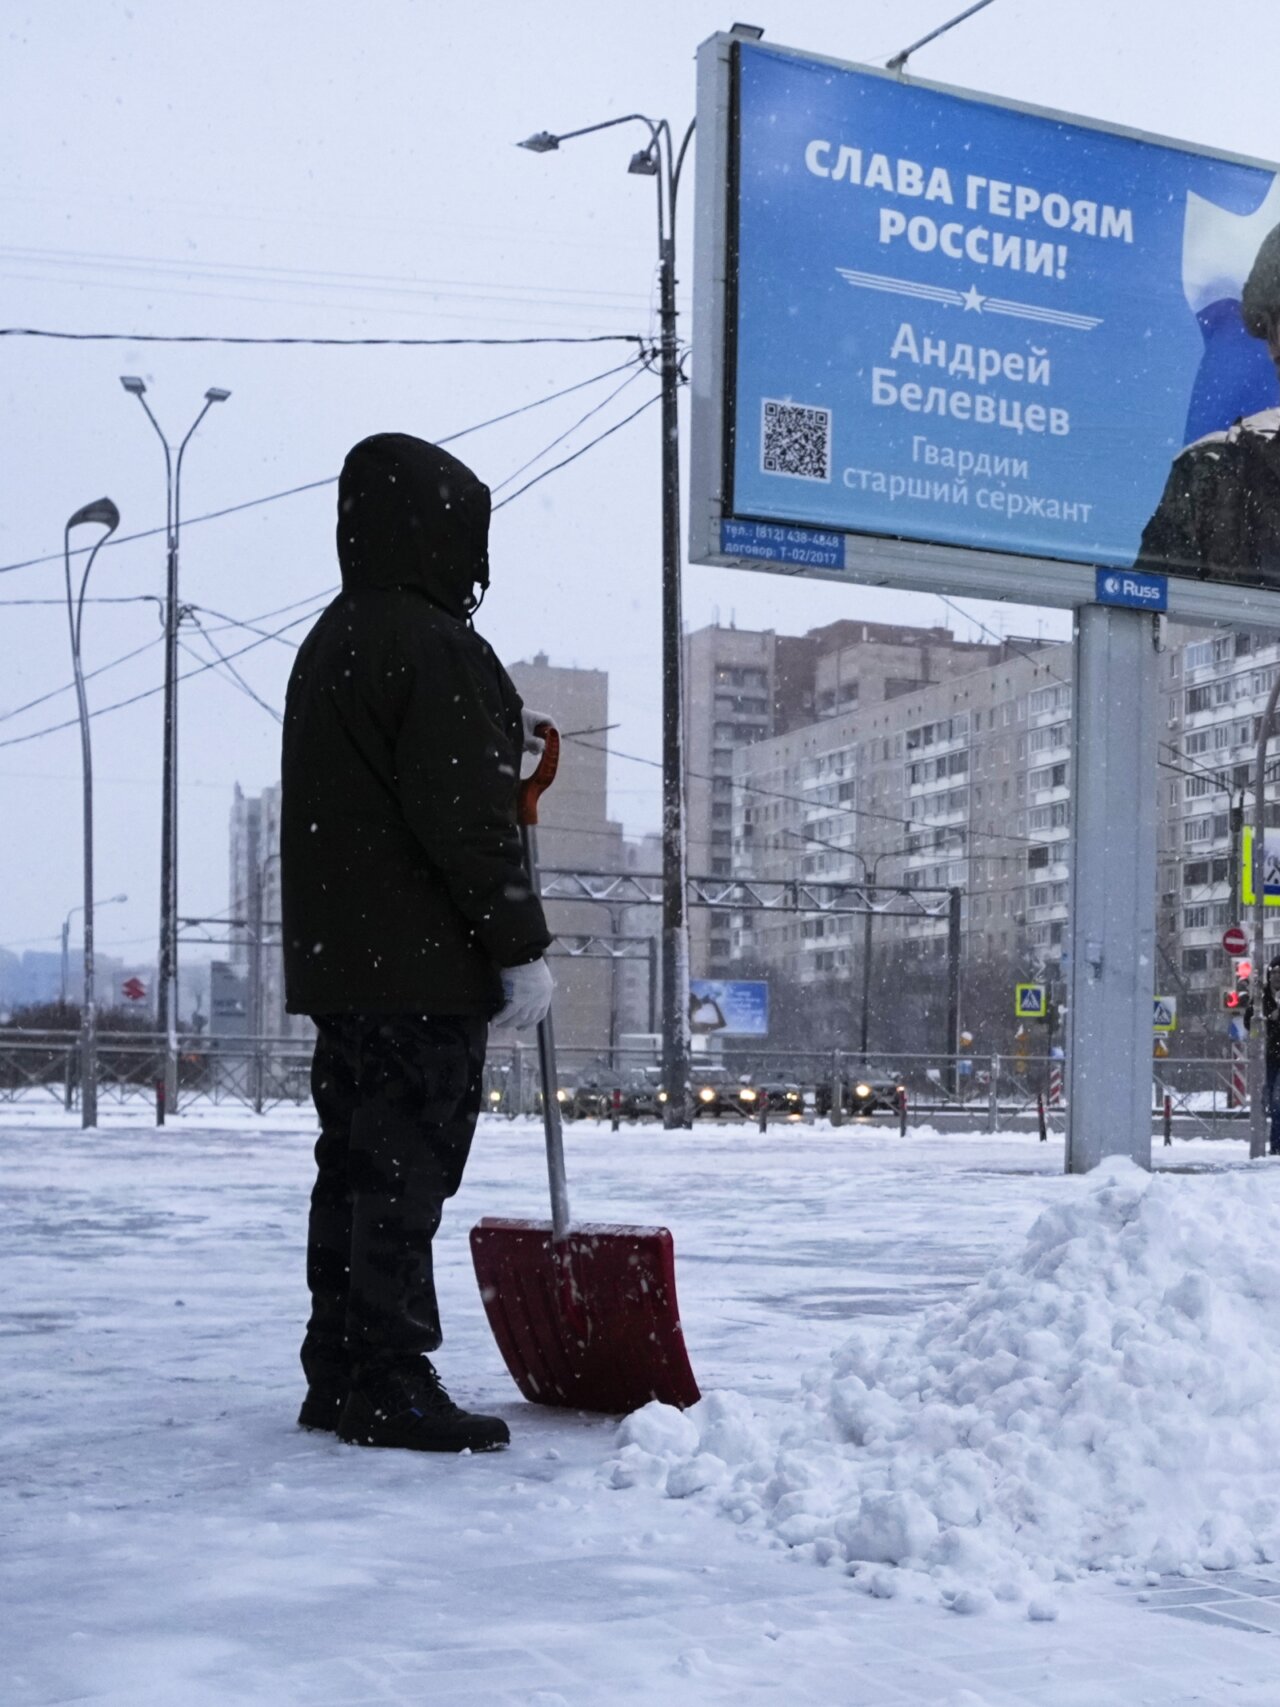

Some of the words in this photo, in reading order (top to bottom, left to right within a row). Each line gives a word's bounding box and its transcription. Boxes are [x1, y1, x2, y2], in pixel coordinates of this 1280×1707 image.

[804, 139, 954, 205] СЛАВА
[966, 174, 1134, 243] ГЕРОЯМ
[878, 207, 1069, 280] РОССИИ!
[890, 322, 1051, 386] Андрей
[871, 366, 1070, 436] Белевцев
[912, 435, 1029, 480] Гвардии
[843, 467, 968, 506] старший
[975, 486, 1093, 524] сержант
[725, 525, 753, 537] тел.:
[756, 525, 784, 541] (812)
[787, 531, 839, 548] 438-4848
[725, 542, 776, 558] договор:
[1123, 579, 1160, 600] Russ
